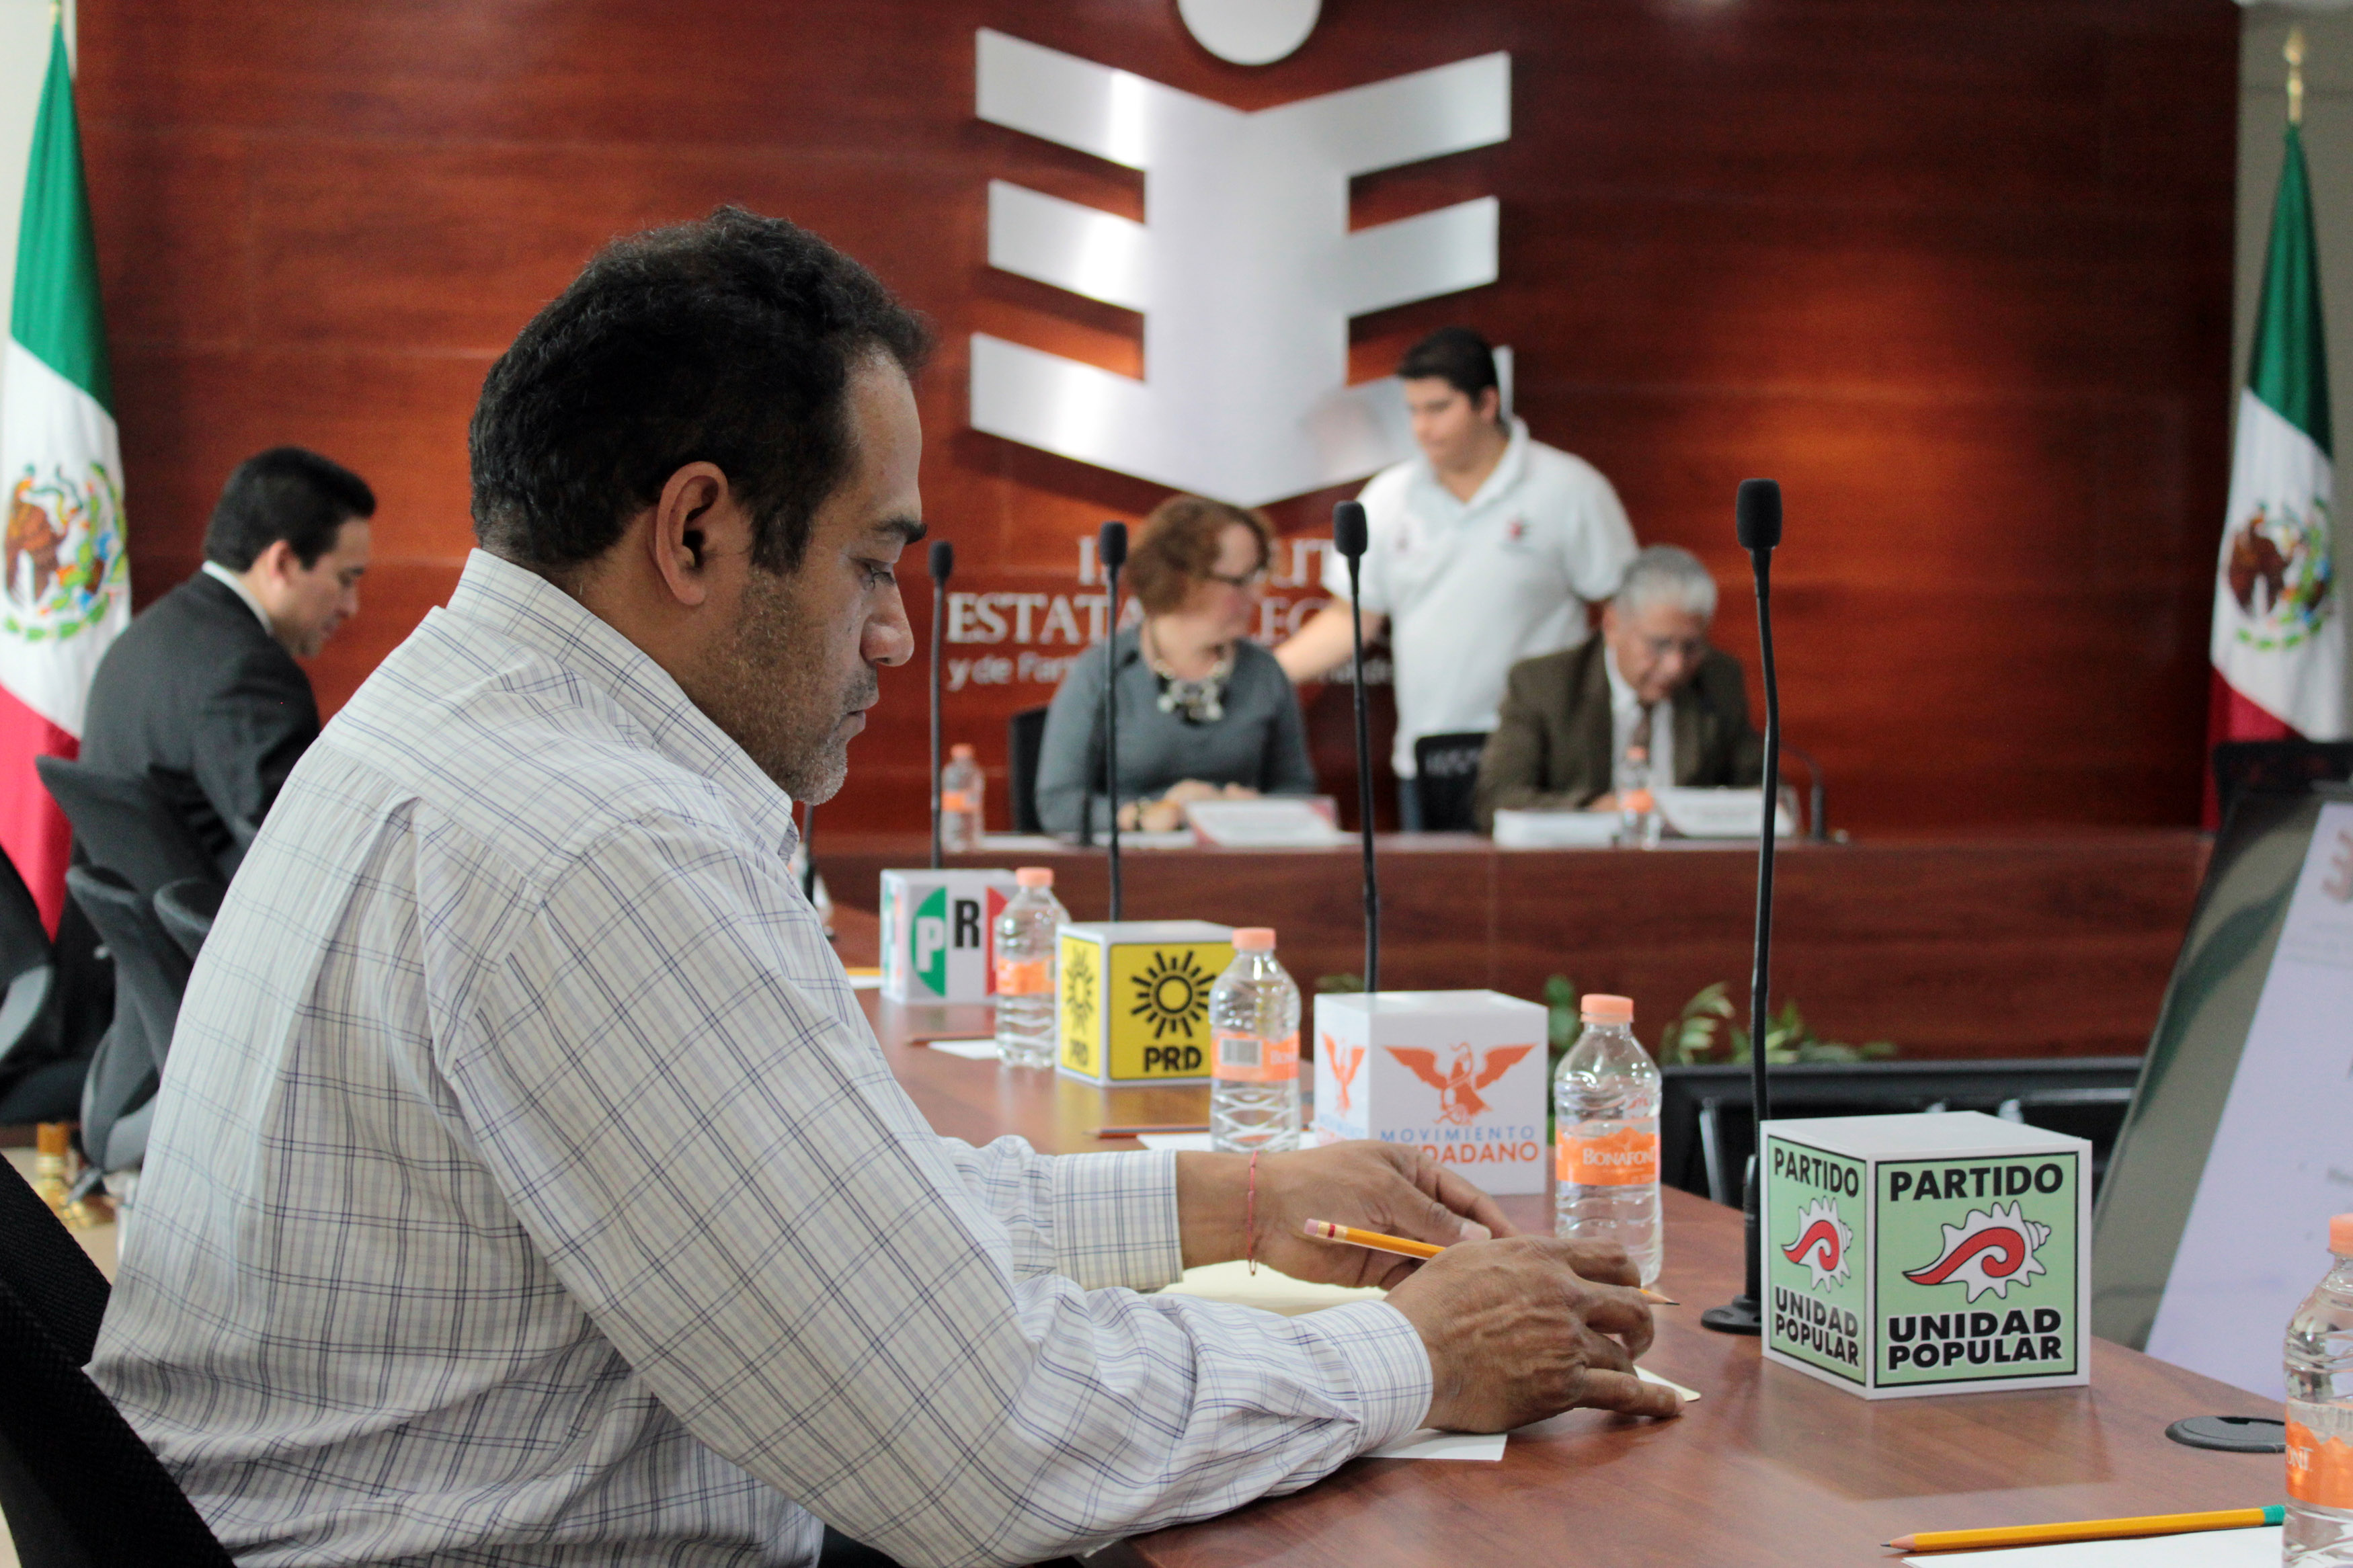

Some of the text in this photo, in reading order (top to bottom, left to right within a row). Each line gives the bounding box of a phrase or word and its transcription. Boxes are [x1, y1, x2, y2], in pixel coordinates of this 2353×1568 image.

[947, 591, 1144, 644] ESTATA
[916, 899, 998, 973] PR
[1144, 1046, 1202, 1072] PRD
[1380, 1125, 1535, 1142] MOVIMIENTO
[1414, 1141, 1539, 1163] DADANO
[1774, 1147, 1859, 1198] PARTIDO
[1890, 1163, 2063, 1202] PARTIDO
[1775, 1286, 1858, 1338] UNIDAD
[1888, 1309, 2062, 1343] UNIDAD
[1775, 1313, 1859, 1367] POPULAR
[1888, 1336, 2063, 1370] POPULAR
